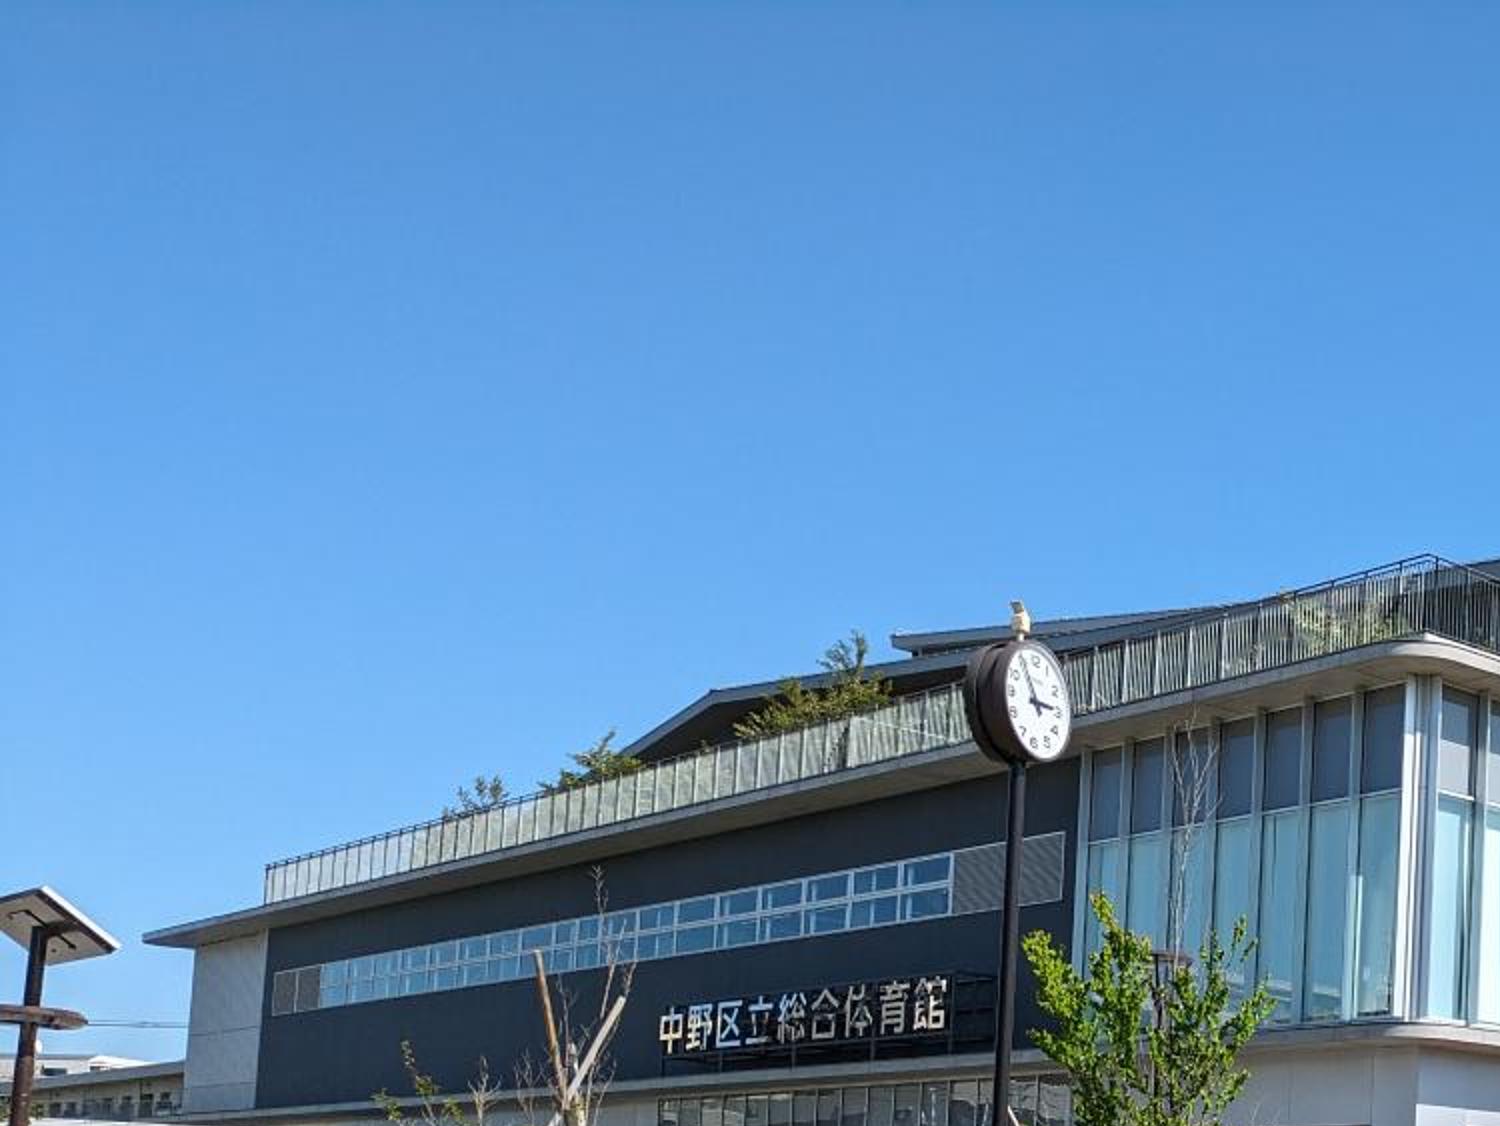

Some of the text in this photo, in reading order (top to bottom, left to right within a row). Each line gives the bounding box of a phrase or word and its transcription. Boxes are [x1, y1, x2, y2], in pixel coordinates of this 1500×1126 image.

[1051, 685, 1059, 698] 2
[1050, 725, 1059, 736] 4
[659, 976, 947, 1054] 中野区立総合体育館
